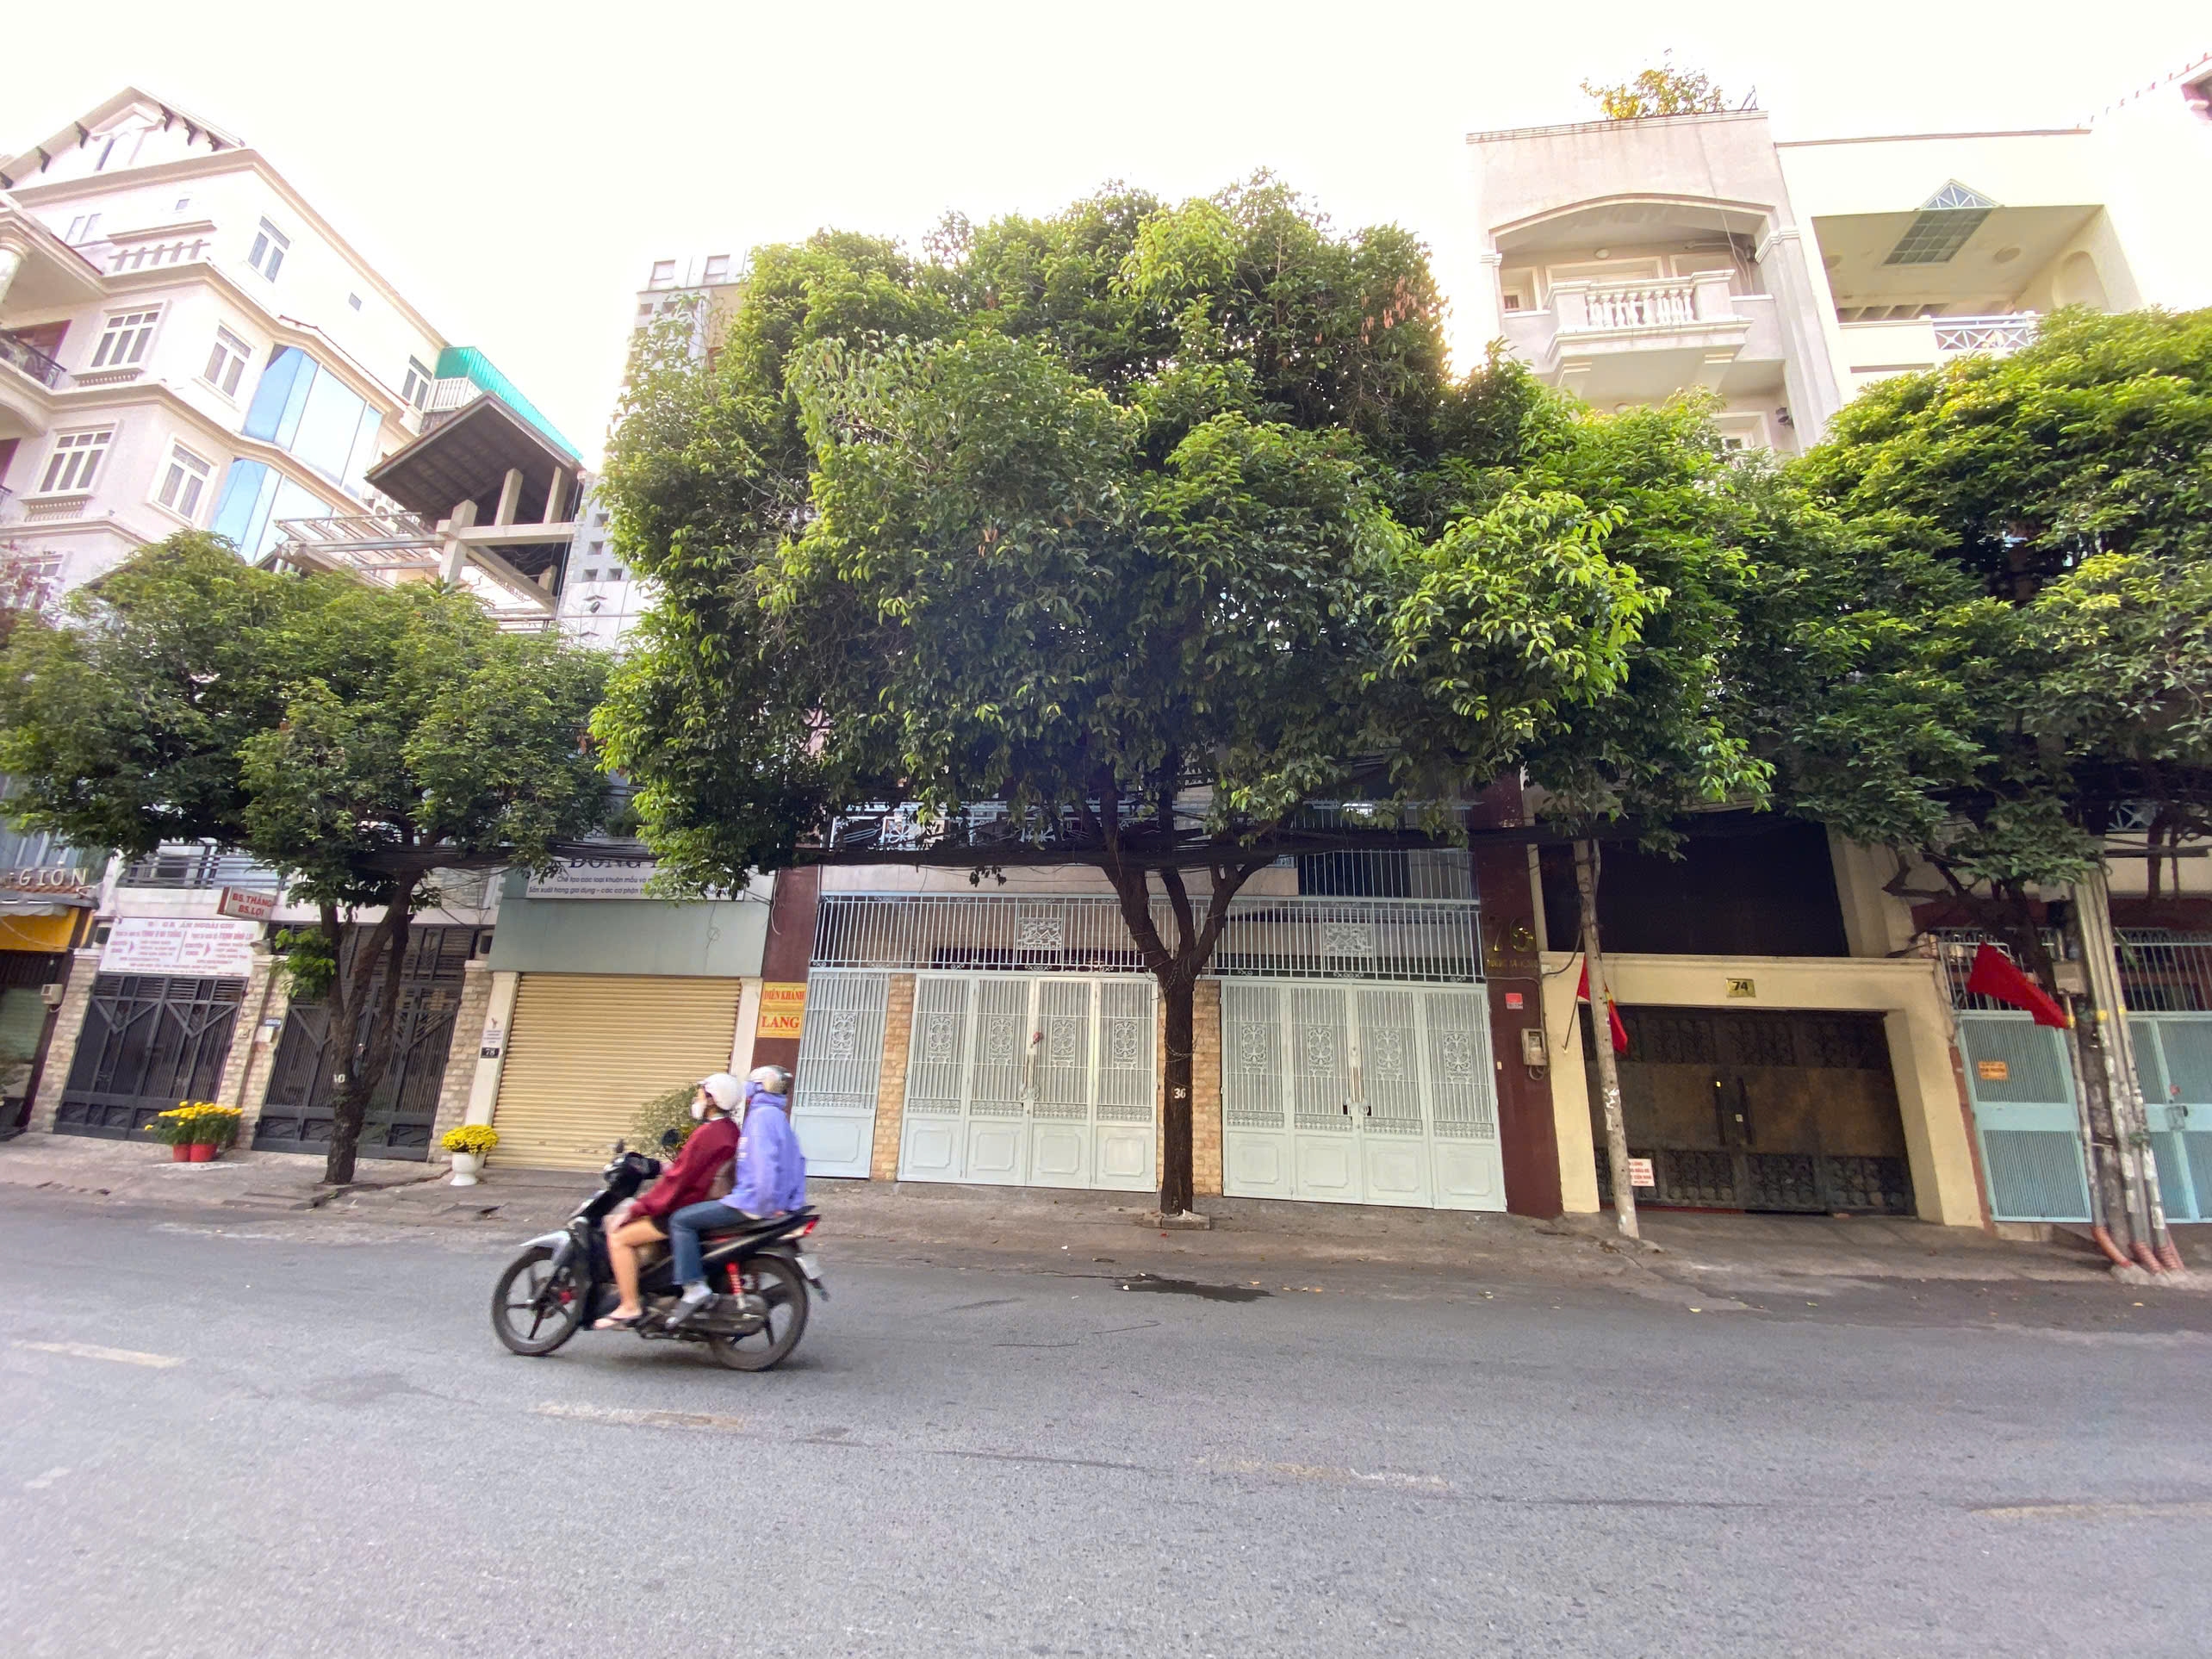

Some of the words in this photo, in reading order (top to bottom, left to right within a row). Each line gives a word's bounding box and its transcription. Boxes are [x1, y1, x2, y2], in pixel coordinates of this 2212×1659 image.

[5, 867, 89, 887] GION
[1731, 981, 1749, 991] 74
[761, 1016, 799, 1028] LANG
[1174, 1088, 1186, 1099] 36
